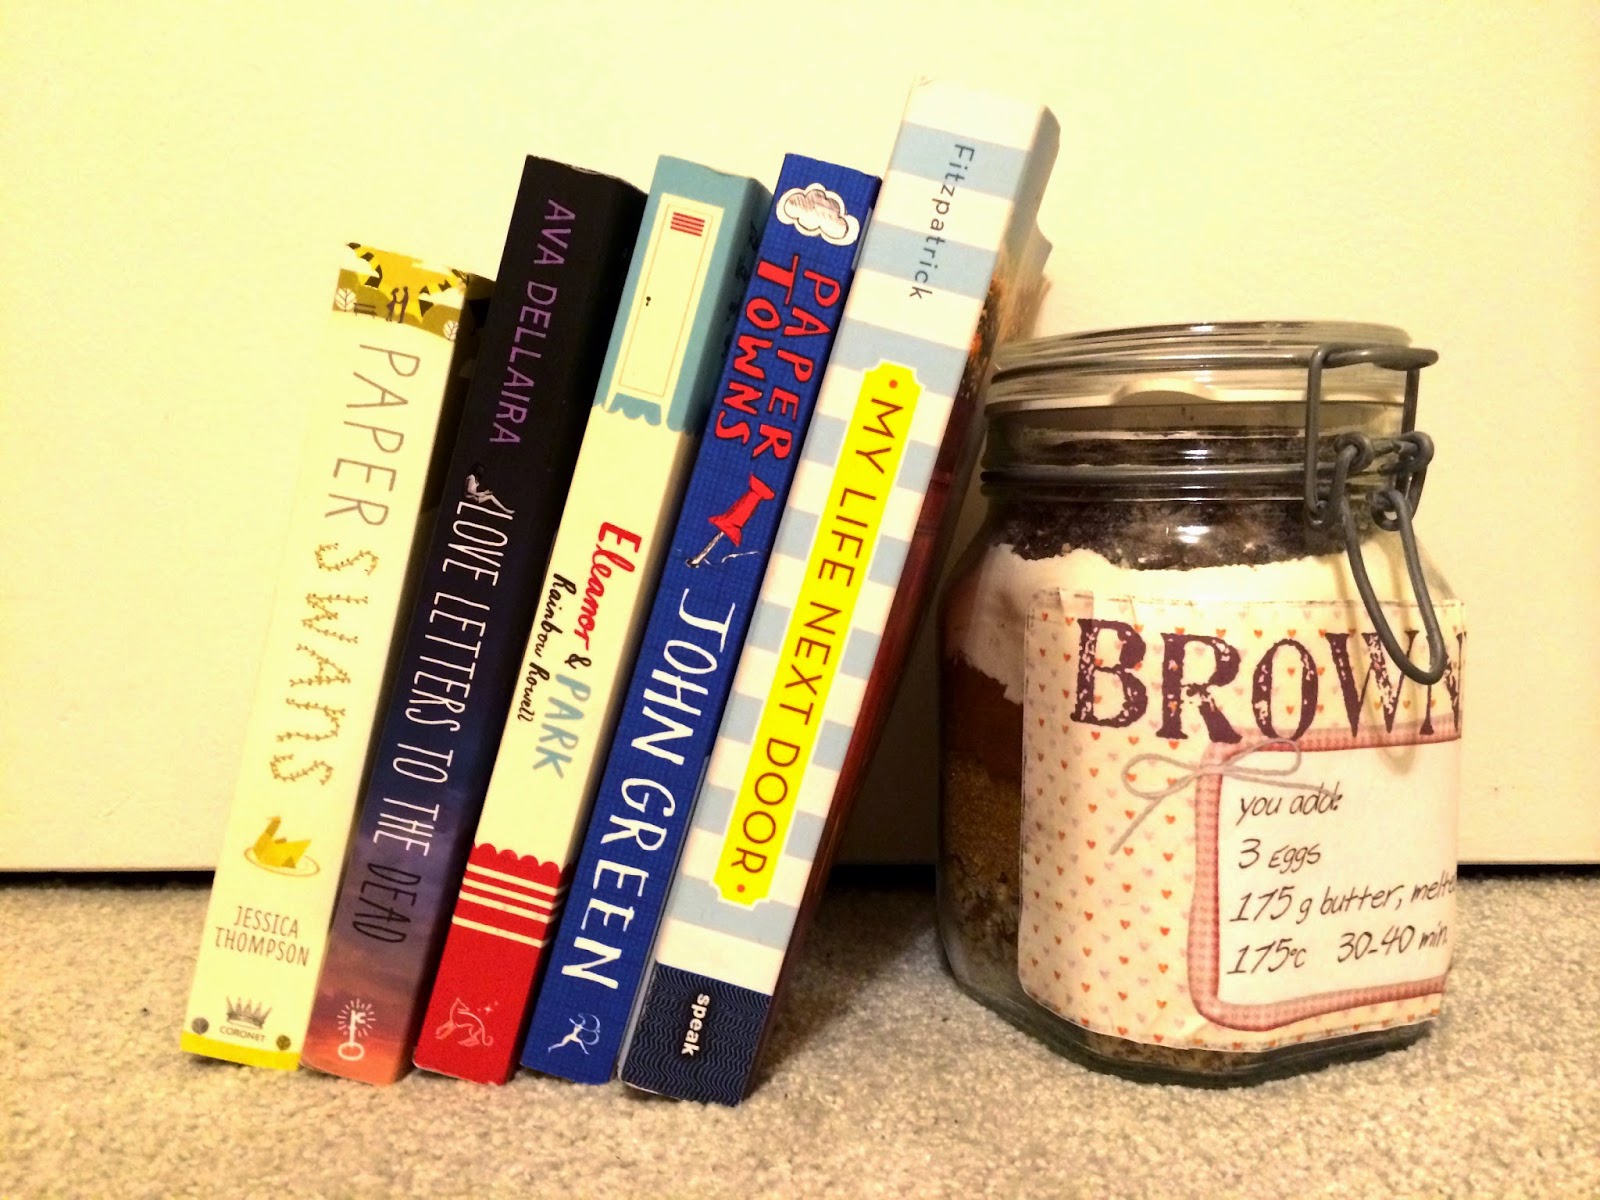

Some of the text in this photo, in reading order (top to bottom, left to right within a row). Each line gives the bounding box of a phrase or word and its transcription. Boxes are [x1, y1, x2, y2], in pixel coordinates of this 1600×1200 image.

[909, 143, 975, 300] Fitzpatrick
[489, 199, 576, 443] AVA DELLAIRA
[714, 255, 799, 445] TOWNS
[752, 268, 842, 460] PAPER
[325, 344, 421, 526] PAPER
[518, 573, 577, 722] Rainbow Rowell
[533, 521, 642, 779] Eleanor & PARK
[730, 398, 905, 875] MY LIFE NEXT DOOR
[352, 501, 513, 944] LOVE LETTERS TO THE DEAD
[561, 588, 735, 990] JOHN GREEN
[1236, 795, 1282, 826] you
[1238, 838, 1260, 869] 3
[215, 927, 310, 967] THOMPSON
[233, 906, 299, 937] JESSICA
[1229, 886, 1295, 923] 175
[1296, 898, 1313, 925] g
[1320, 885, 1405, 914] butter,
[1337, 925, 1415, 964] 30-40
[220, 1026, 266, 1042] CORONET
[681, 994, 710, 1057] speak
